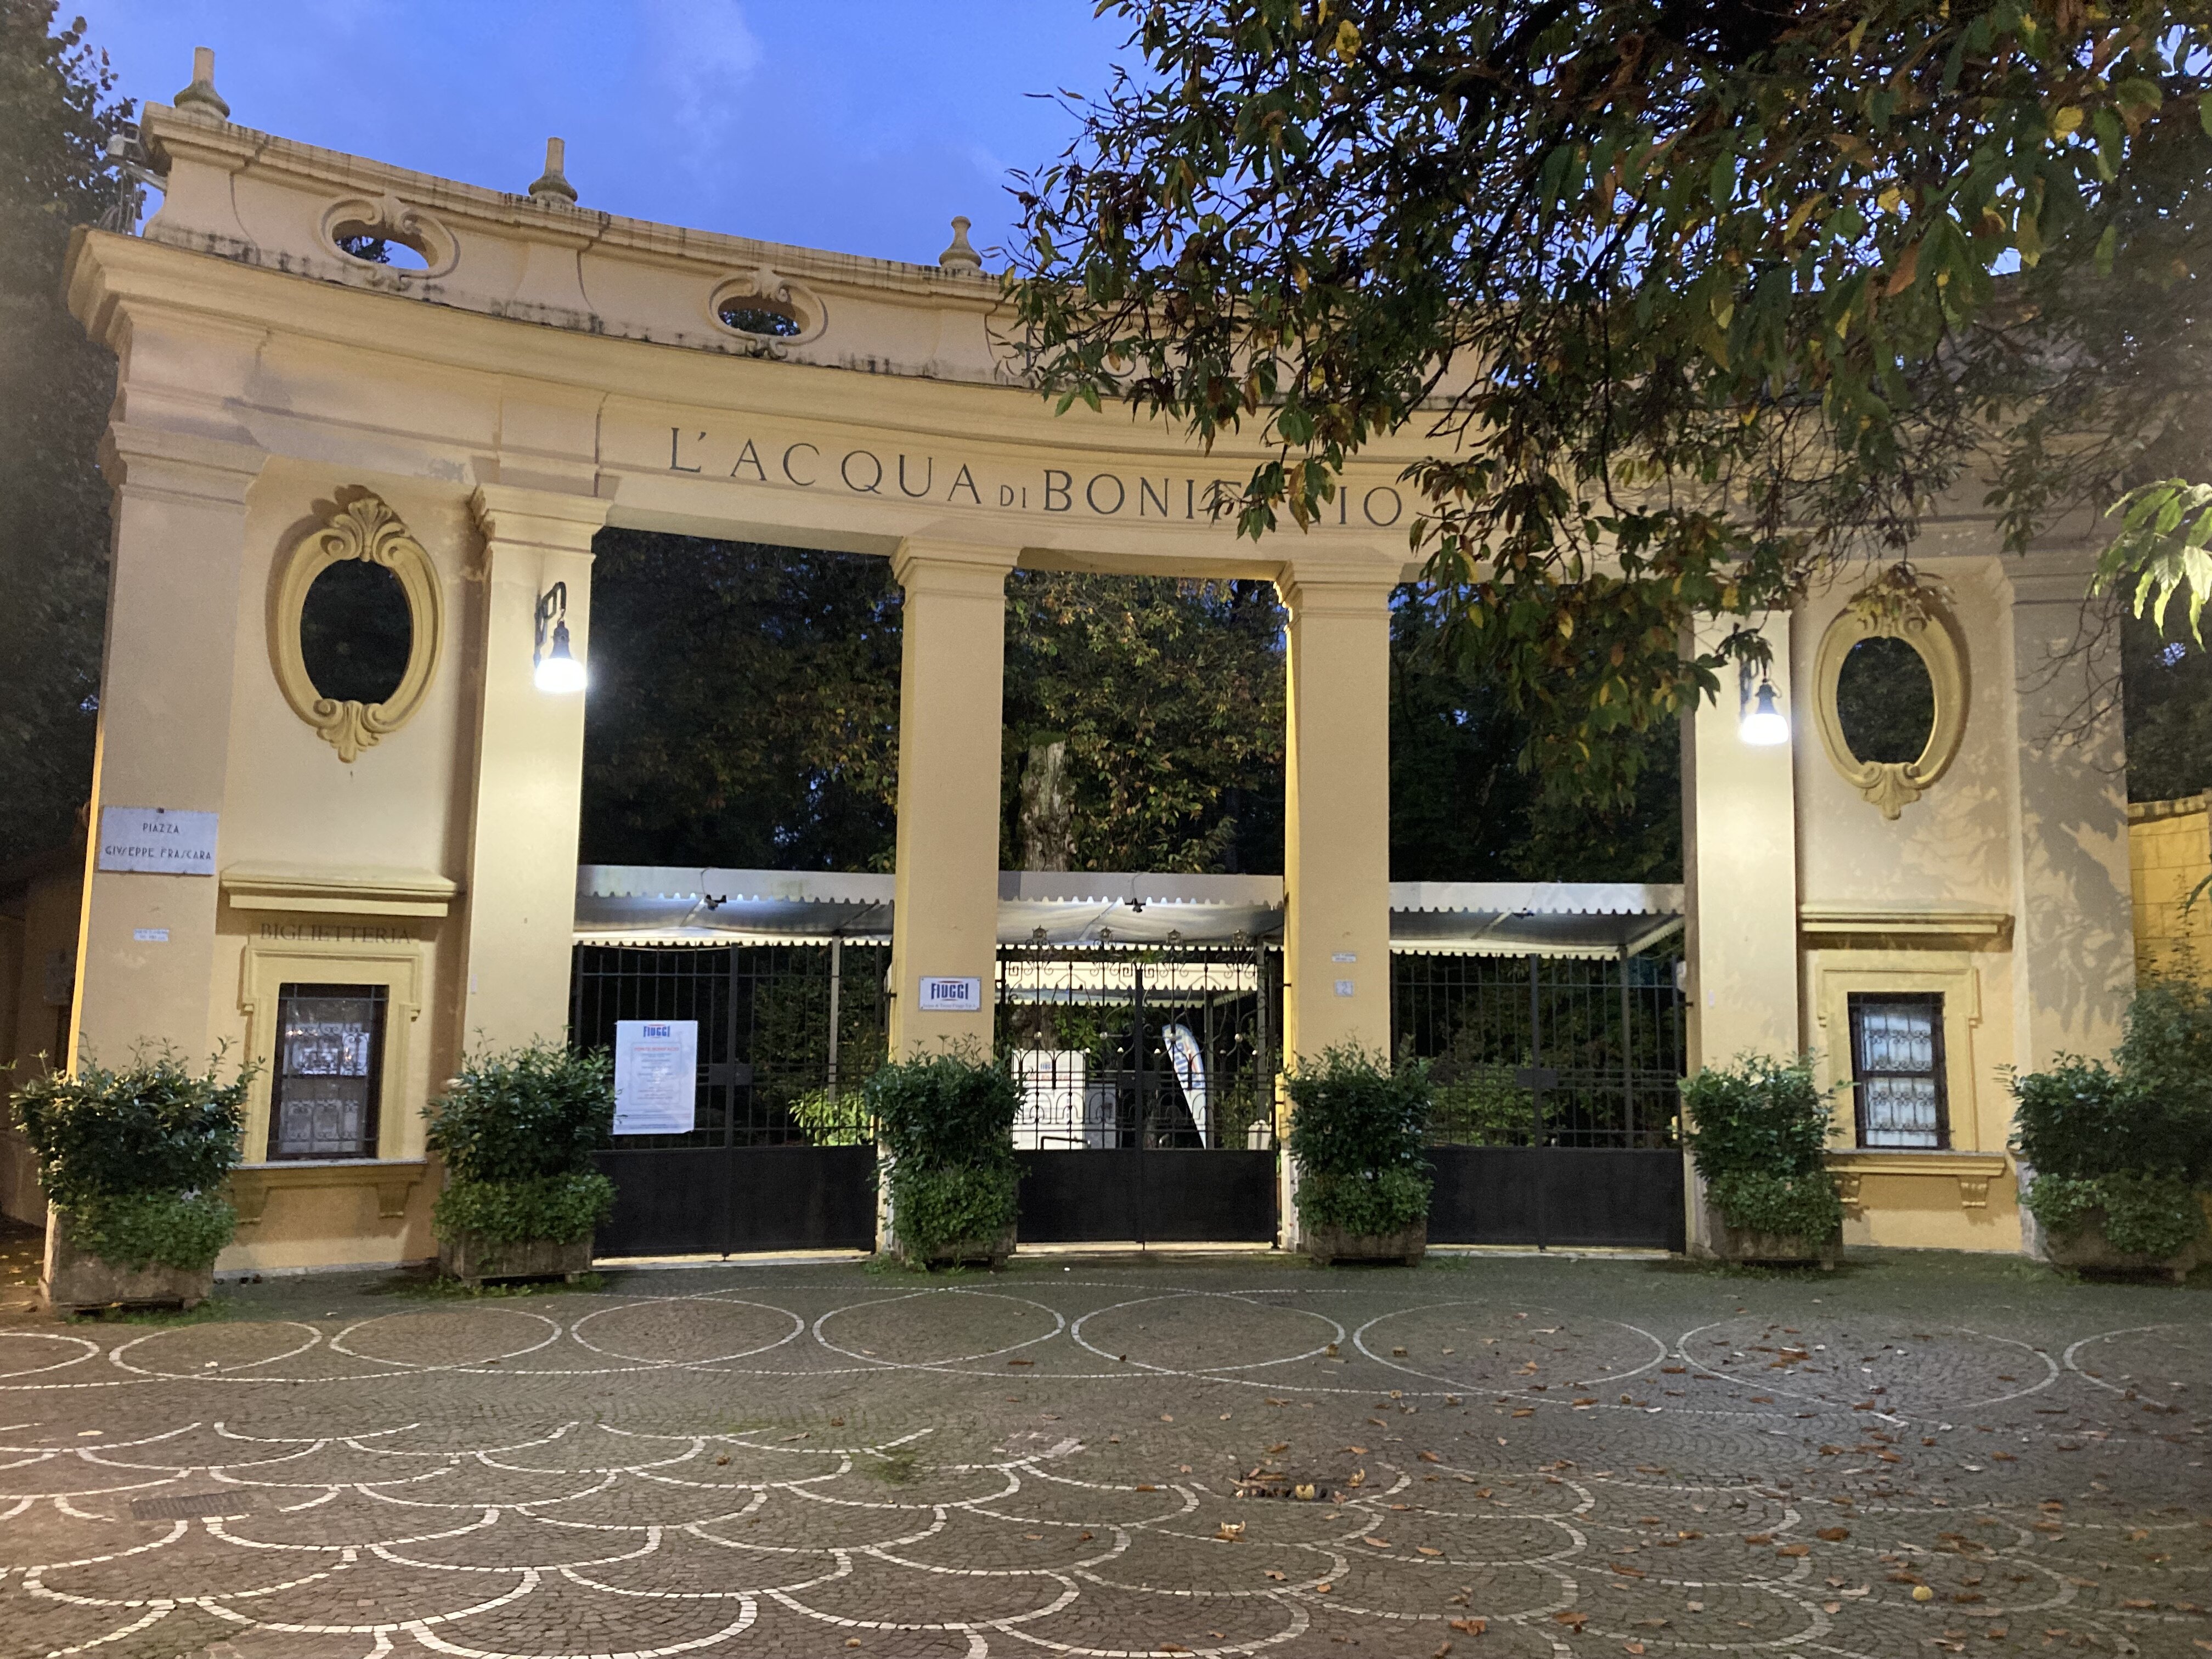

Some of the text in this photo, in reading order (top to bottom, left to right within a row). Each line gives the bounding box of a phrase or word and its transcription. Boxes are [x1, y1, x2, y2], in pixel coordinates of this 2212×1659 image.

[669, 426, 1402, 527] L'ACQUA DI BONIFIO
[142, 822, 180, 834] PIAZZA
[160, 848, 211, 860] FRASCARA
[260, 923, 411, 944] BIGLIETTERIA
[930, 983, 969, 1000] FIUGGI
[643, 1025, 670, 1037] FIUGGI
